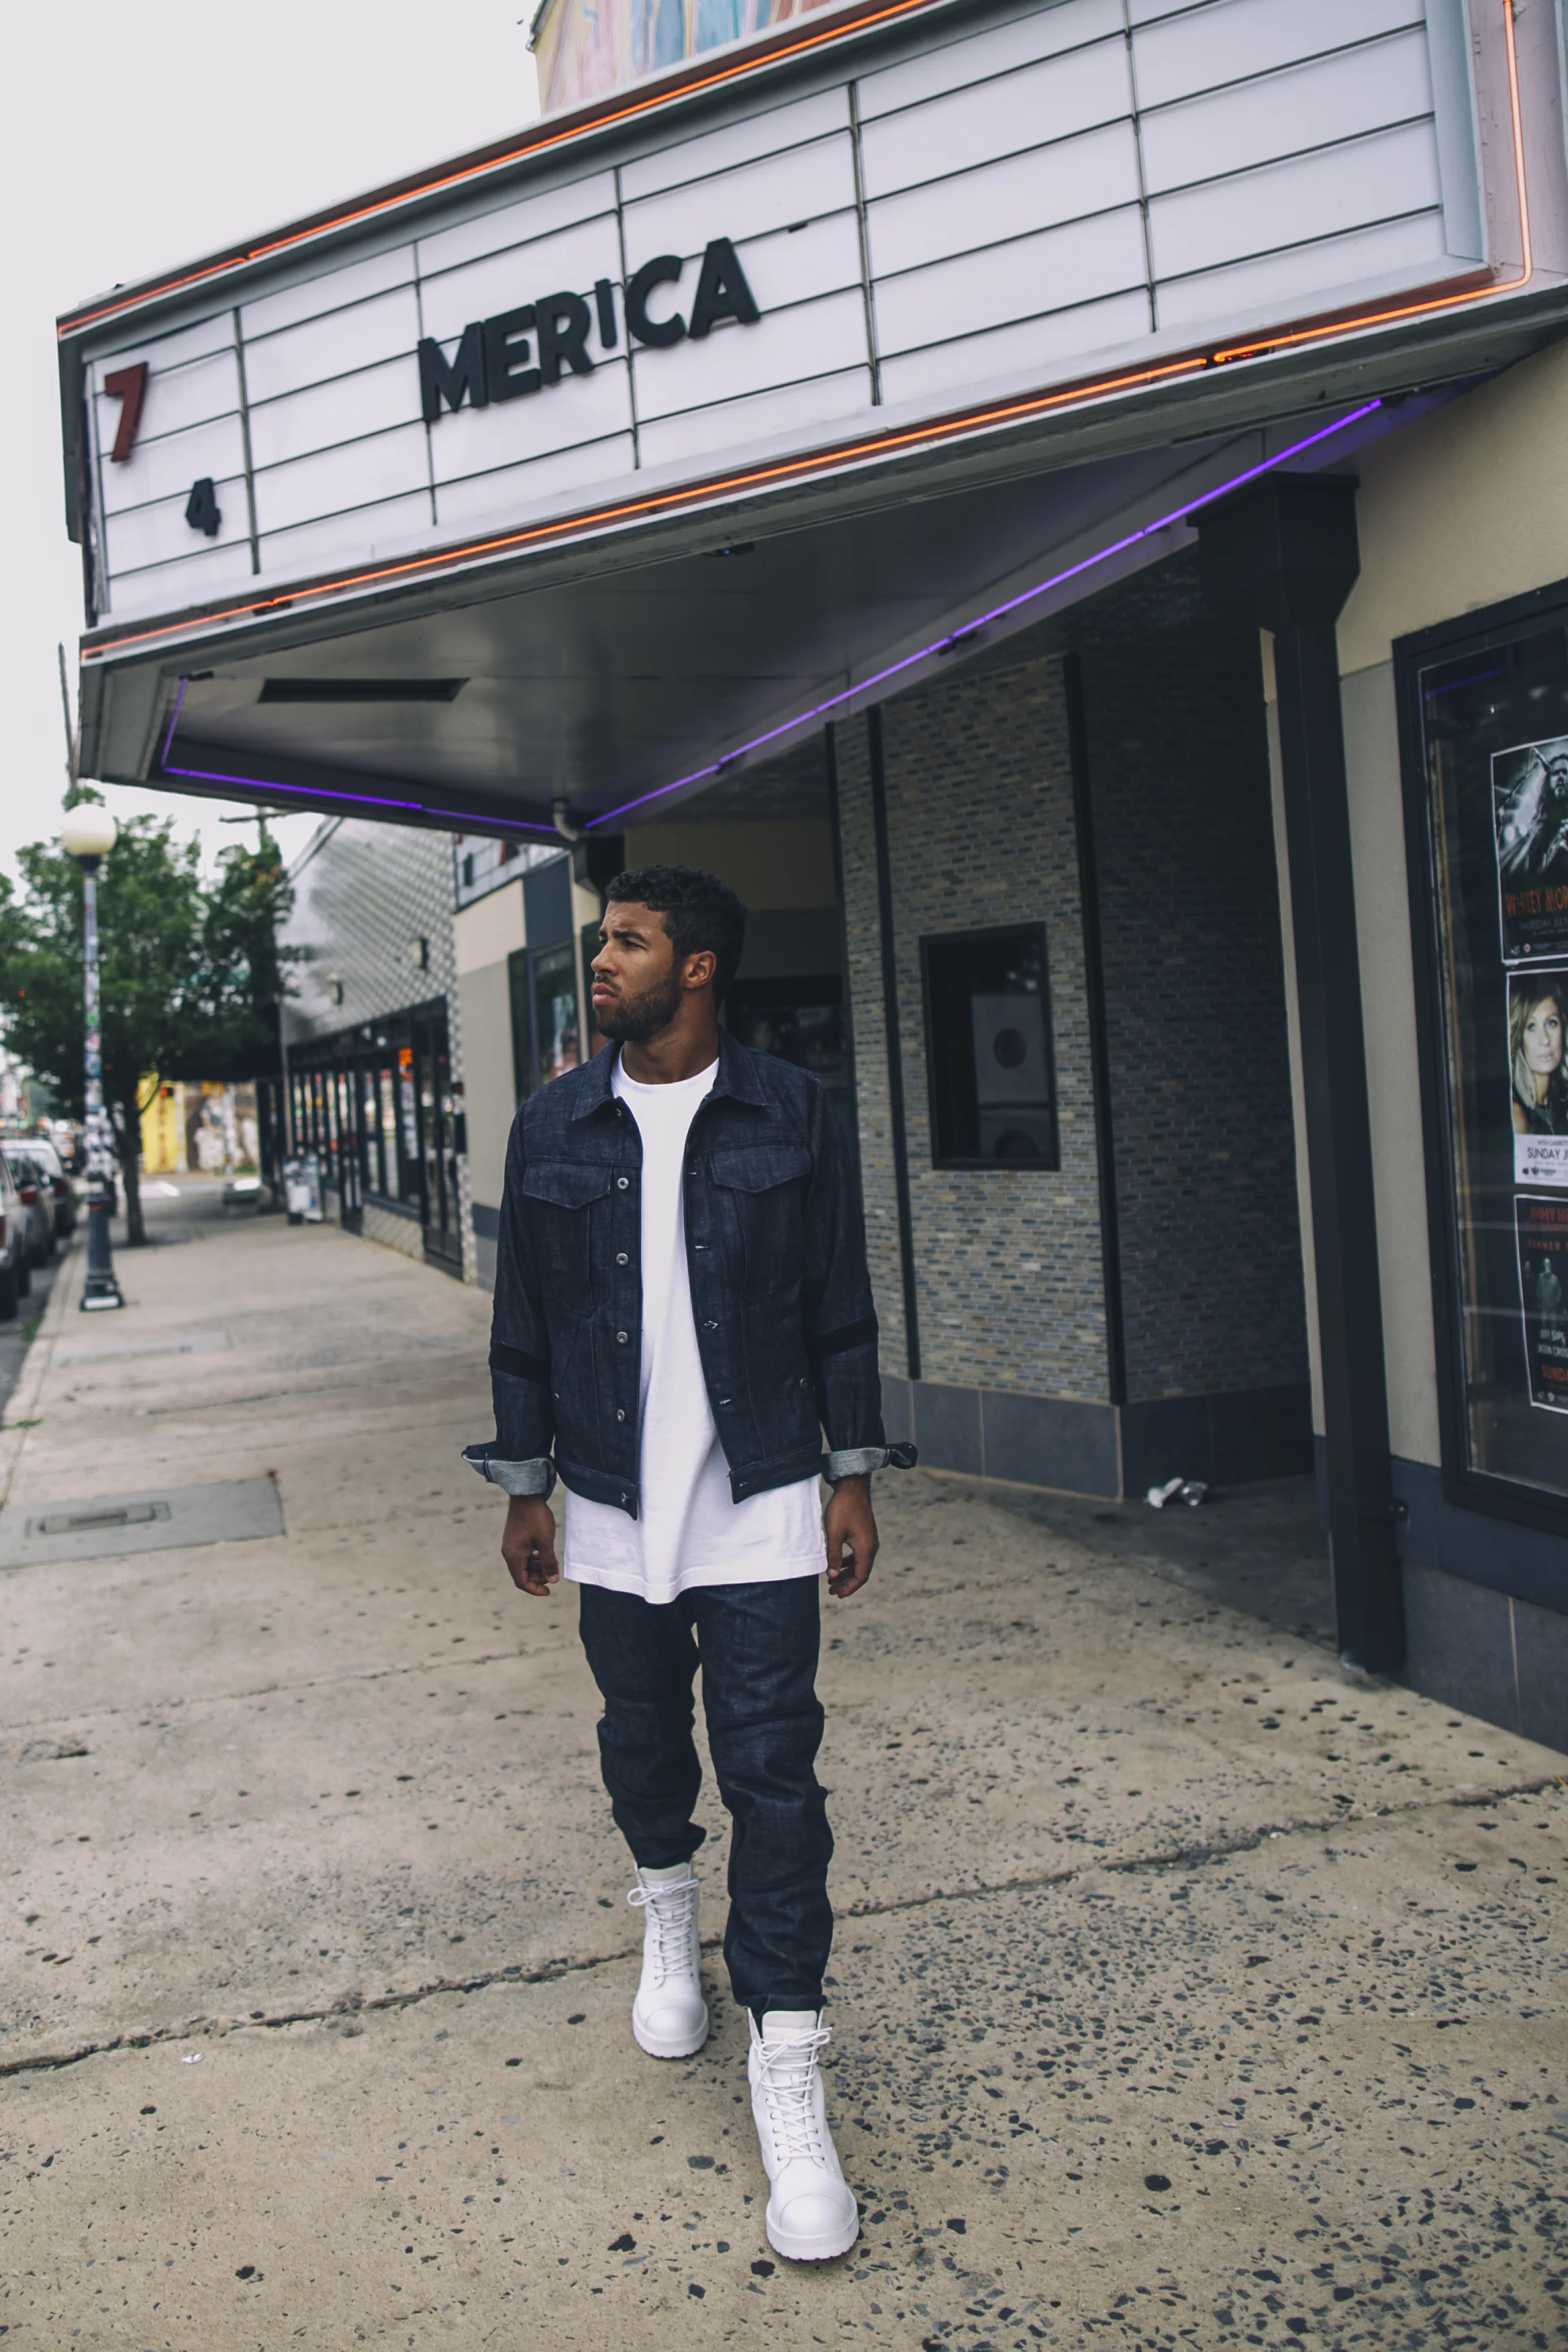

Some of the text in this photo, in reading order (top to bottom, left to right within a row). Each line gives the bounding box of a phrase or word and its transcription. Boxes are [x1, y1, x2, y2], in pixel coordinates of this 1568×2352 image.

[417, 236, 761, 423] MERICA
[103, 361, 149, 463] 7
[184, 476, 221, 538] 4
[1505, 889, 1541, 917] WHITEY
[1527, 1147, 1560, 1160] SUNDAY
